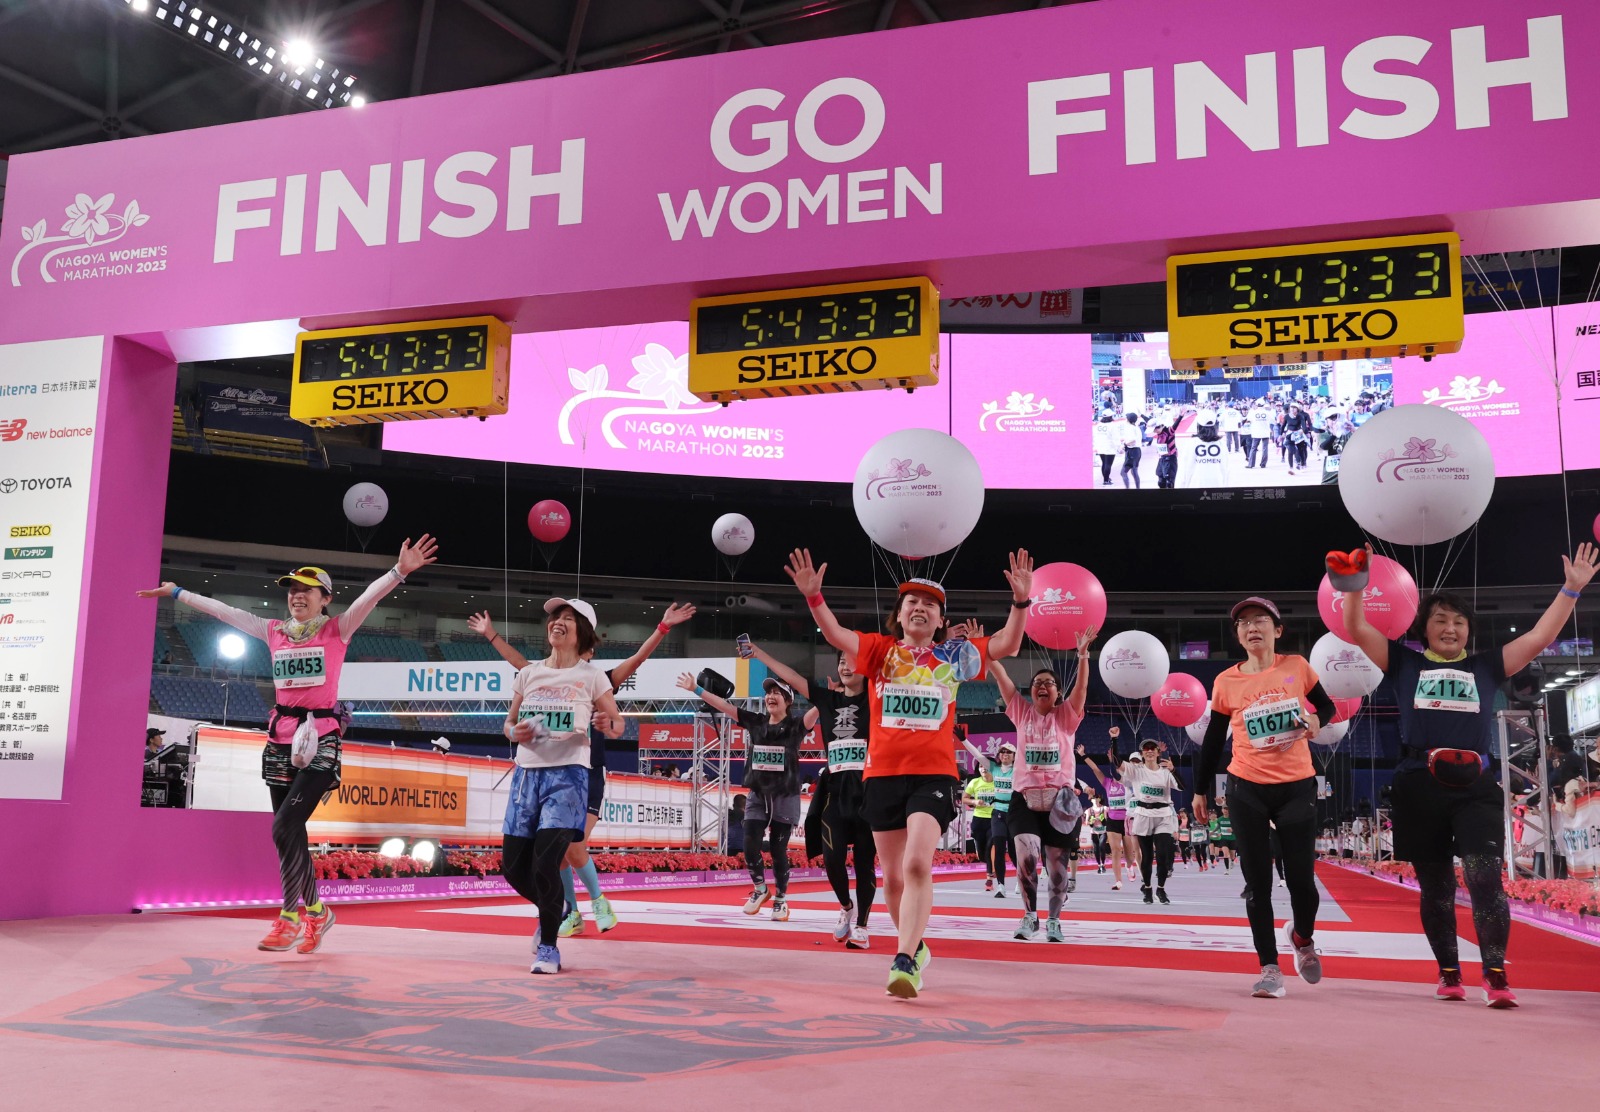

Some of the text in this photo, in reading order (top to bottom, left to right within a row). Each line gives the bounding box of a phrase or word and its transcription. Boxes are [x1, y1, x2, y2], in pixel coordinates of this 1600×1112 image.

[1027, 15, 1568, 176] FINISH
[710, 77, 886, 173] GO
[213, 138, 585, 264] FINISH
[657, 162, 943, 241] WOMEN
[55, 245, 168, 268] NAGOYA WOMEN'S
[63, 260, 167, 282] MARATHON 2023
[1229, 251, 1441, 310] 5:43:33
[742, 294, 915, 348] 5:43:33
[1229, 308, 1399, 350] SEIKO
[339, 331, 484, 378] 5:43:33
[738, 345, 878, 383] SEIKO
[332, 378, 449, 411] SEIKO
[26, 430, 46, 440] new
[49, 427, 93, 438] balance
[625, 419, 785, 441] NAGOYA WOMEN'S
[638, 439, 785, 459] MARATHON 2023
[1195, 444, 1221, 457] GO
[20, 477, 72, 491] TOYOTA
[1242, 488, 1286, 499] 三菱電機
[10, 525, 51, 538] SEIKO
[19, 548, 47, 557] バンテリン
[1, 570, 51, 580] SIXPAD
[274, 657, 322, 677] G16453
[408, 667, 500, 692] Niterra
[885, 687, 909, 695] Niterra
[884, 695, 940, 716] I20057
[1244, 708, 1270, 719] Niterra
[829, 747, 865, 764] F15756
[1025, 751, 1059, 763] G17479
[338, 784, 457, 811] WORLD ATHLETICS
[370, 885, 400, 893] MARATHON
[400, 883, 415, 892] 2023
